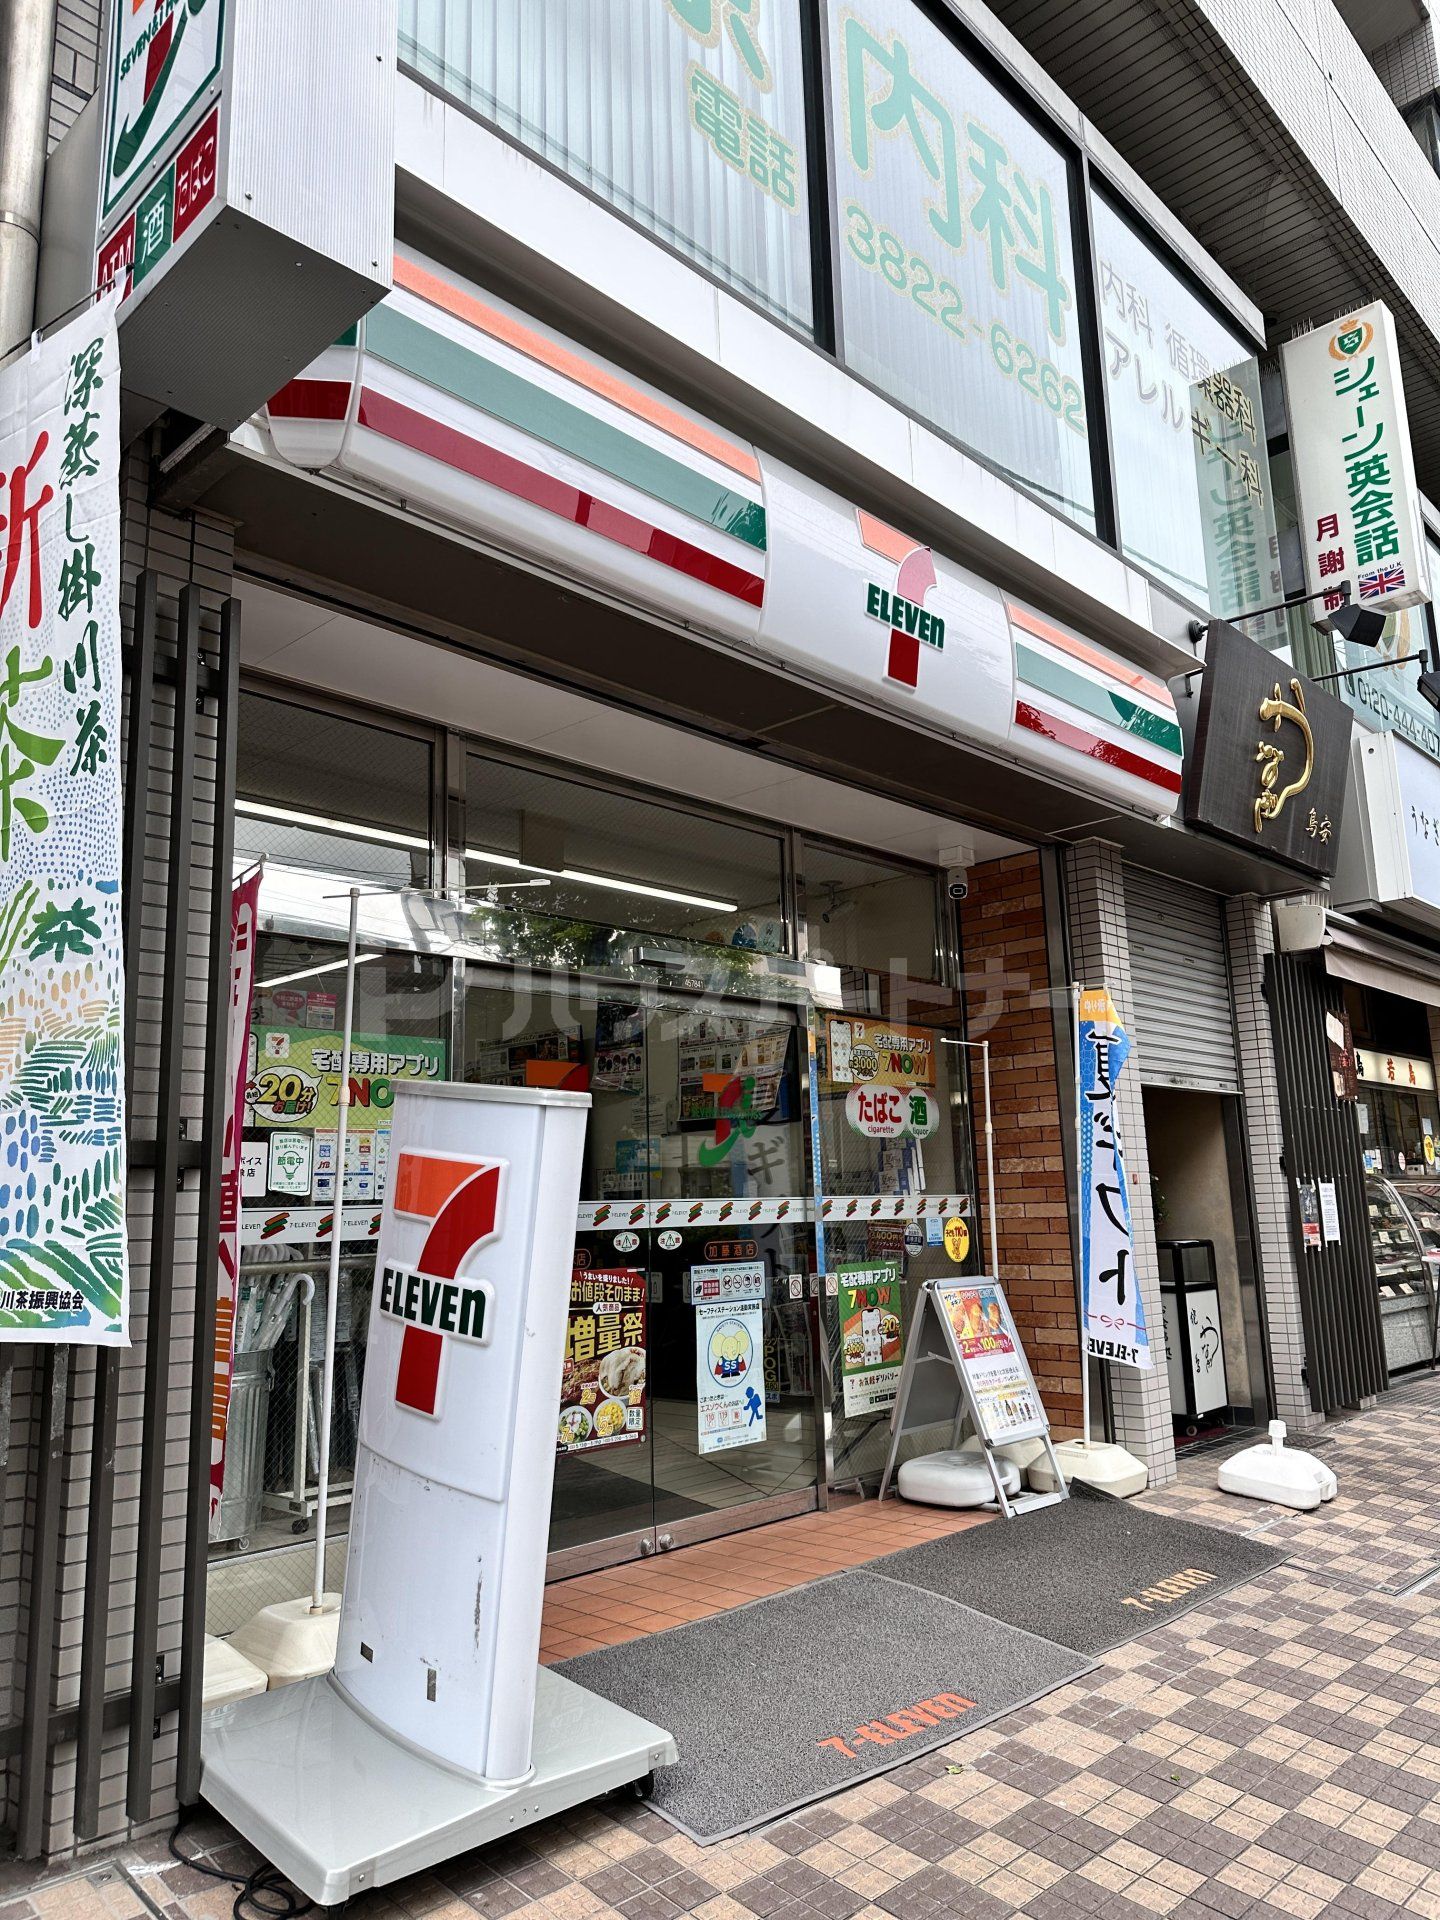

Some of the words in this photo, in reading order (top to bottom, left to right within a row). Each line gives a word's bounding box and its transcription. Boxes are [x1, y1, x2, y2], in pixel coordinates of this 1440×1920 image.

[176, 136, 214, 221] たばこ
[690, 66, 797, 208] 電話
[845, 17, 1067, 340] 内科
[141, 193, 167, 264] 酒
[846, 204, 1086, 434] 3822-6262
[1100, 259, 1153, 349] 内科
[1104, 327, 1263, 507] アレルギー科
[1334, 356, 1399, 566] シェーン英会話
[857, 1091, 902, 1124] たばこ
[867, 1124, 895, 1134] cigarette
[909, 1094, 928, 1126] 酒
[912, 1126, 929, 1135] liquor
[724, 1361, 737, 1370] SS
